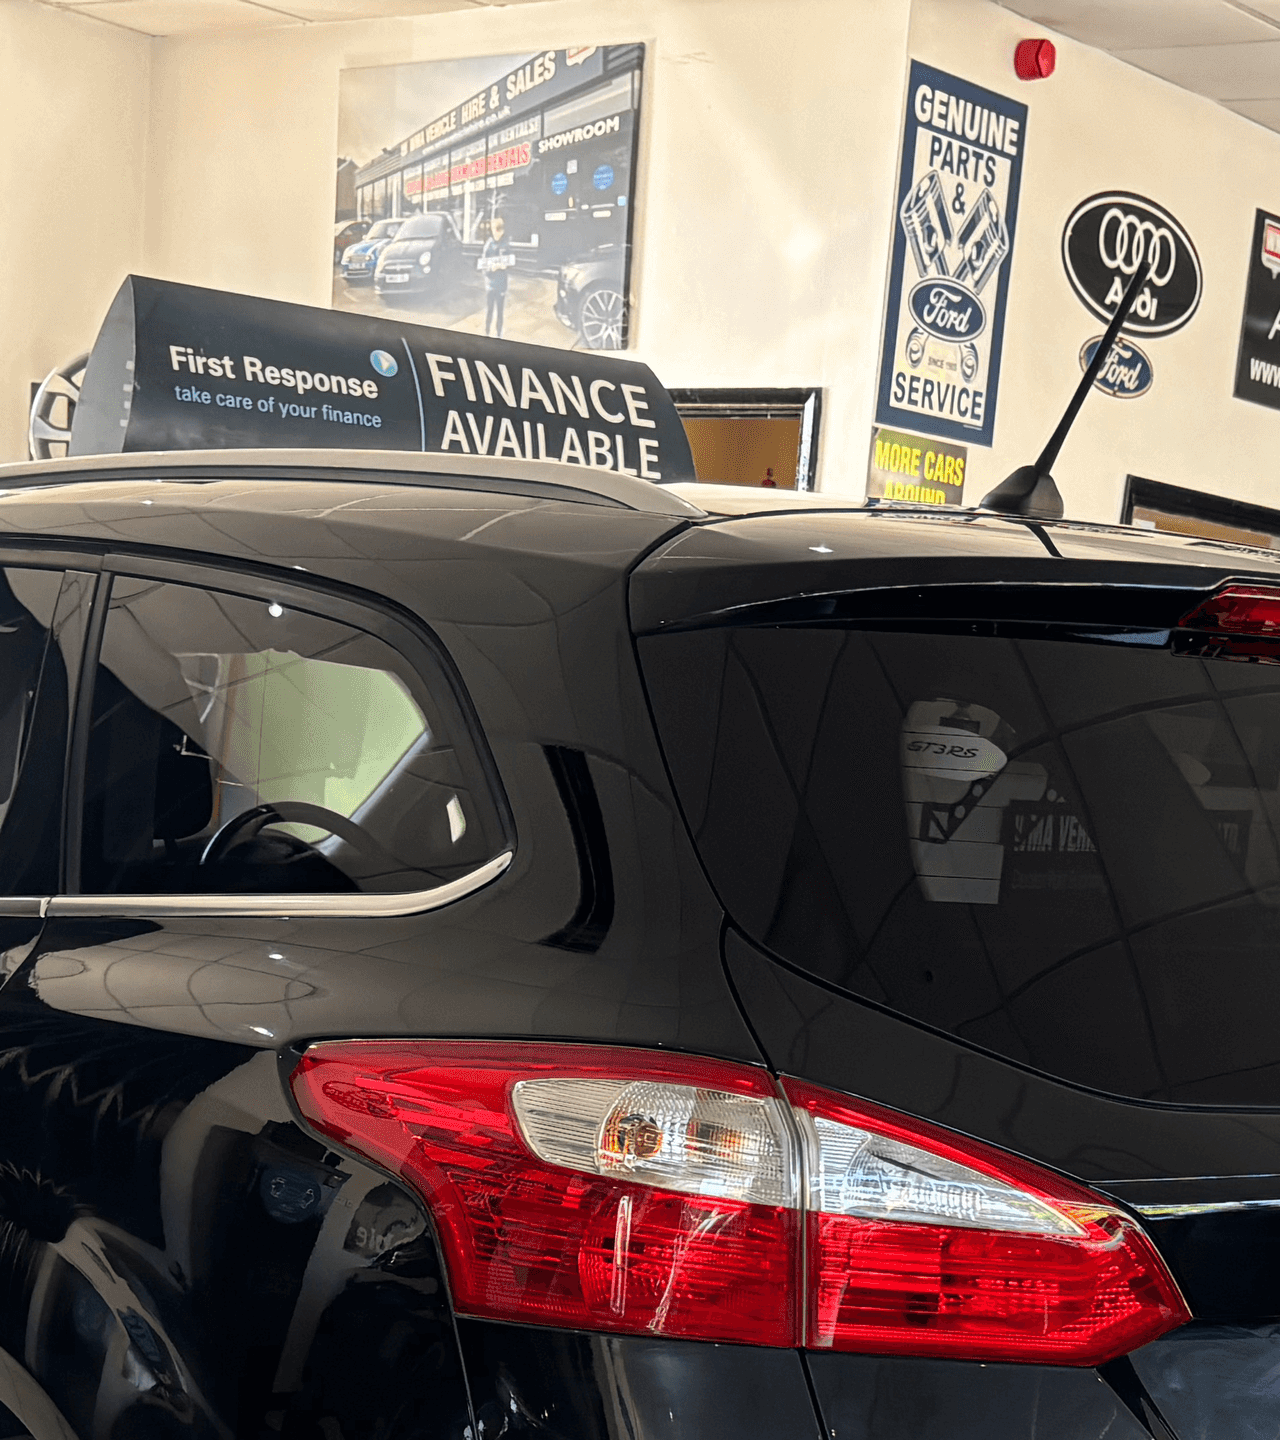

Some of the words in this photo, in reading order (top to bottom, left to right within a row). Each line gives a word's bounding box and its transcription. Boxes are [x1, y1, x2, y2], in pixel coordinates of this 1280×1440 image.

[461, 93, 486, 125] HIRE
[490, 85, 500, 109] &
[506, 50, 557, 100] SALES
[538, 115, 620, 153] SHOWROOM
[915, 84, 1020, 156] GENUINE
[929, 134, 996, 187] PARTS
[952, 182, 966, 216] &
[923, 287, 973, 333] Ford
[1104, 276, 1158, 321] Adi
[169, 345, 236, 379] First
[243, 355, 379, 399] Response
[425, 352, 656, 429] FINANCE
[893, 371, 983, 421] SERVICE
[174, 386, 211, 404] take
[215, 394, 253, 410] care
[257, 397, 275, 413] of
[278, 402, 317, 418] your
[321, 404, 382, 428] finance
[440, 409, 662, 480] AVAILABLE
[874, 439, 921, 477] MORE
[924, 450, 965, 487] CARS
